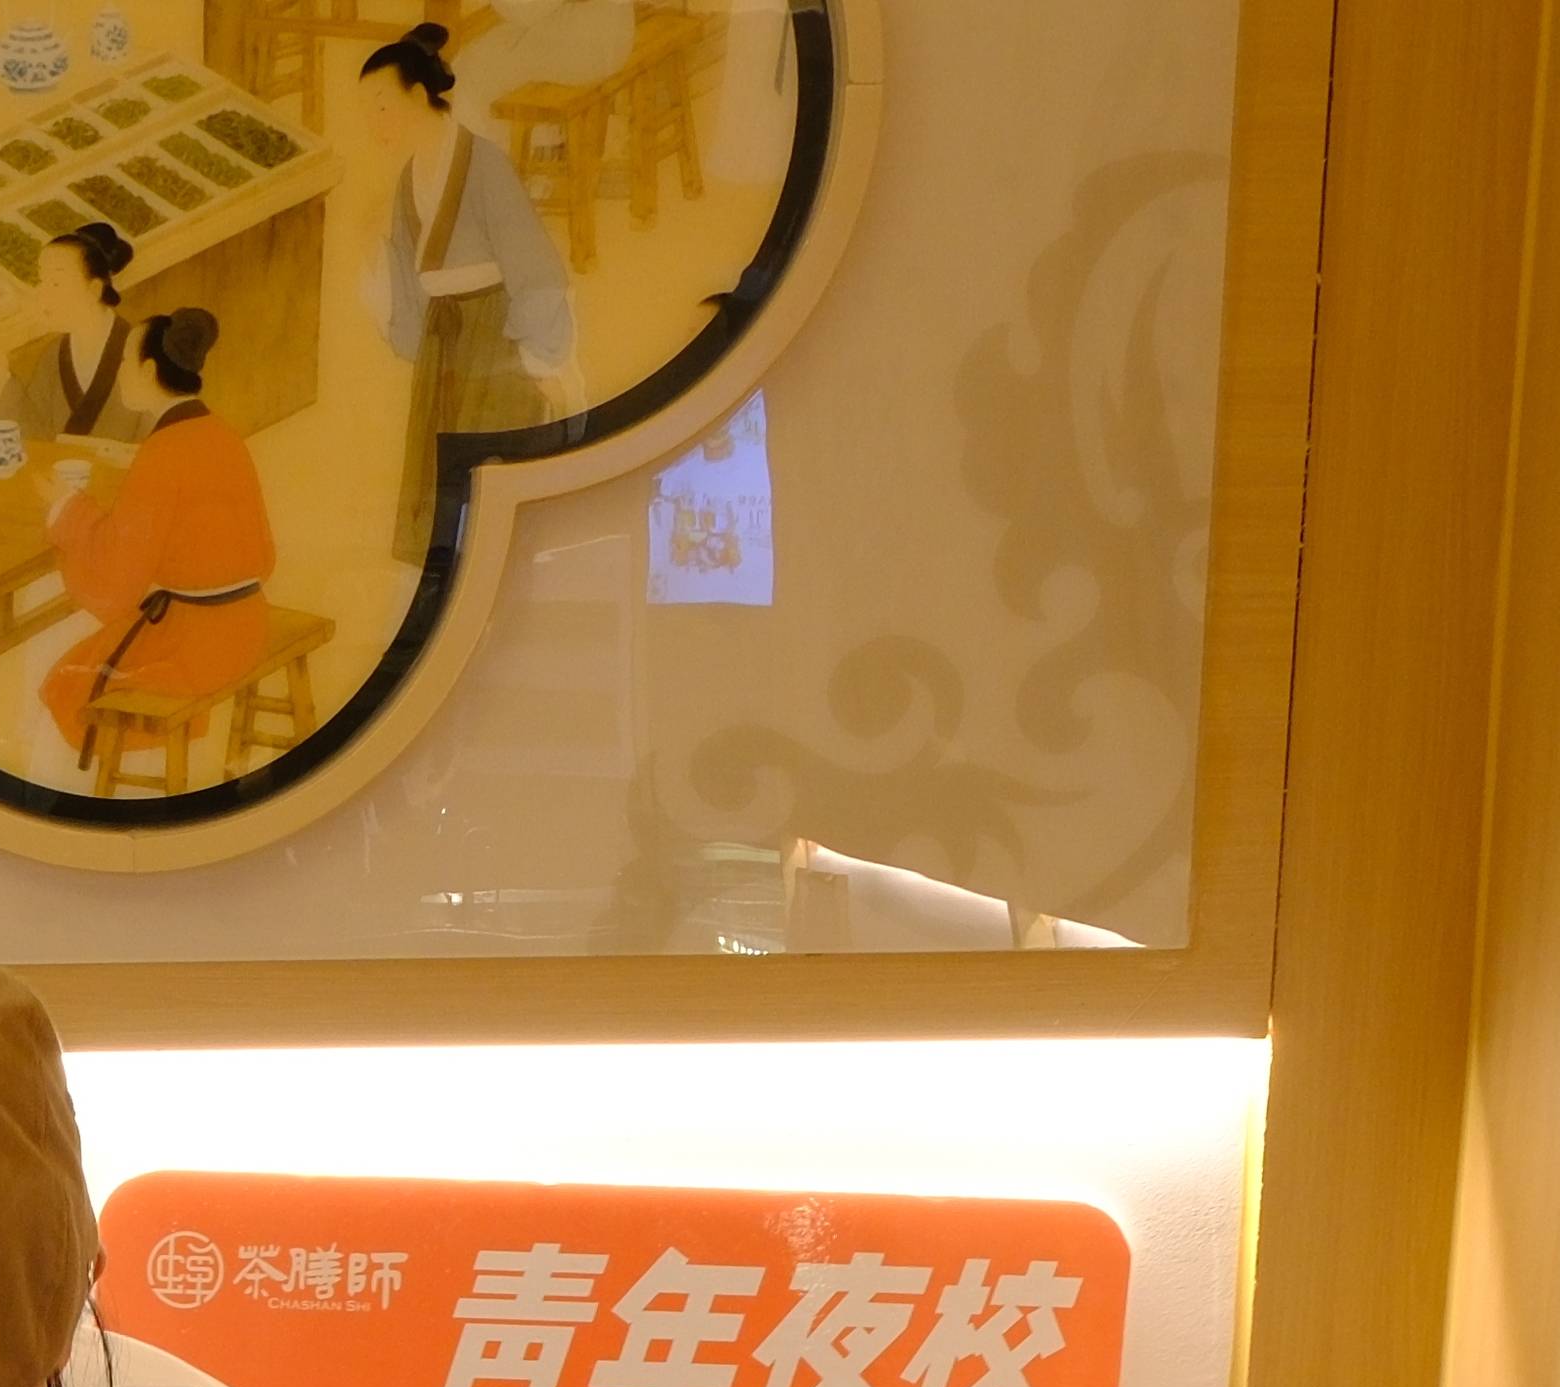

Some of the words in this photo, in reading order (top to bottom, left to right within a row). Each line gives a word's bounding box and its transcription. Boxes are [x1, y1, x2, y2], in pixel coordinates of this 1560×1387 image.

[233, 1242, 409, 1310] 茶膳師
[266, 1297, 343, 1311] CHASHAN
